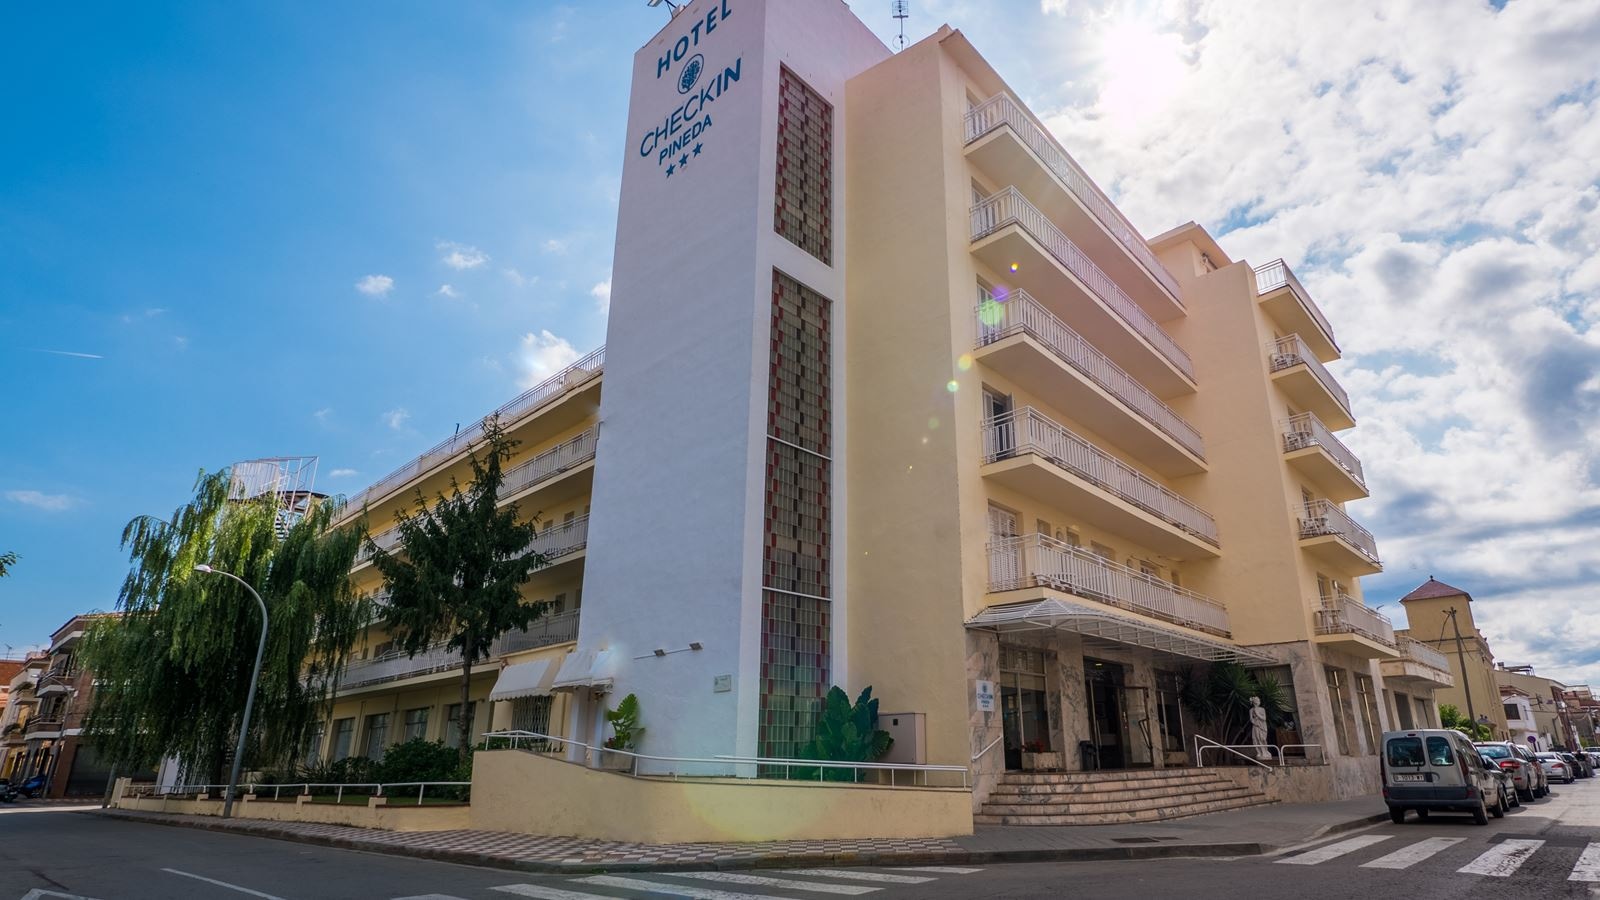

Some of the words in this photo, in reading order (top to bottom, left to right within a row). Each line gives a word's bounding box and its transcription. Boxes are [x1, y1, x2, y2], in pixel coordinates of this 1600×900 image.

[657, 0, 732, 79] HOTEL
[640, 58, 742, 157] CHECKIN
[659, 114, 713, 165] PINEDA
